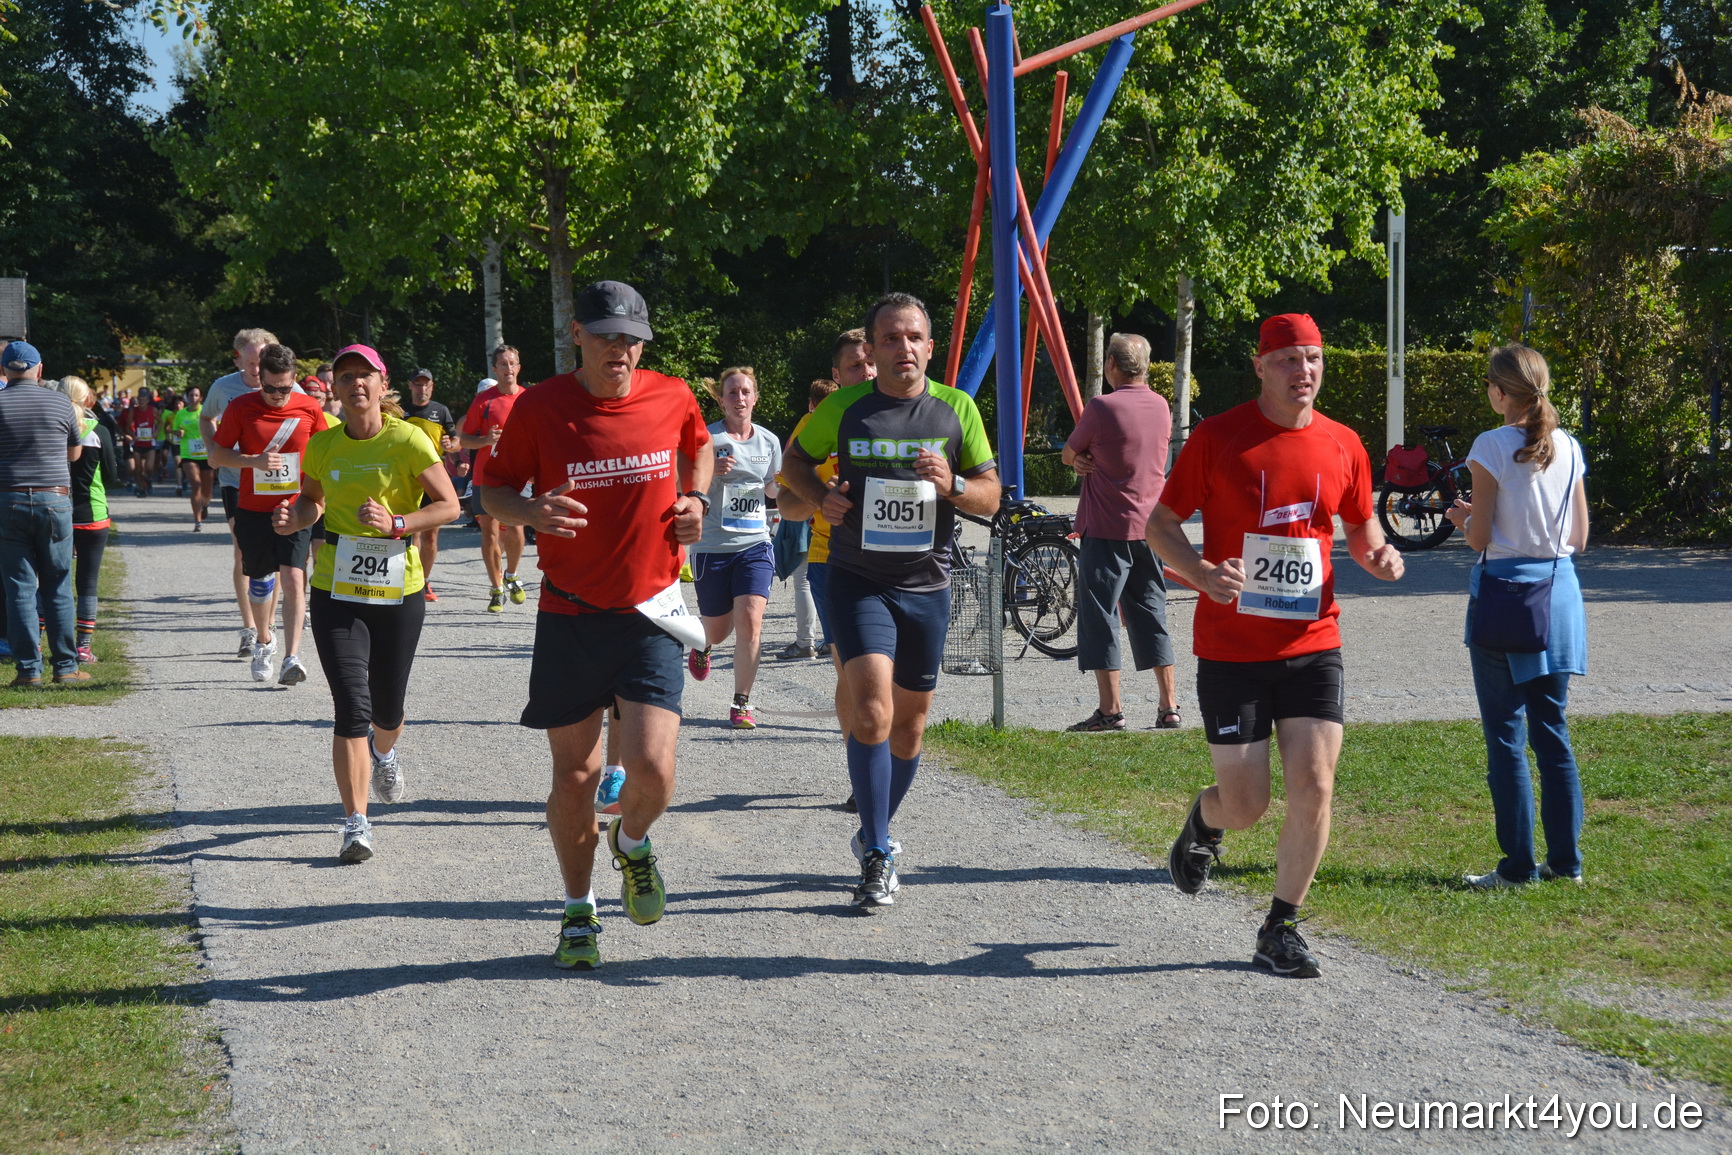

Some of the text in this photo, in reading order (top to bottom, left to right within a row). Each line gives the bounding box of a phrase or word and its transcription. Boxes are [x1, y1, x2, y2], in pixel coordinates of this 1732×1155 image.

[848, 438, 949, 460] BOCK
[567, 450, 670, 475] FACKELMANN
[623, 474, 651, 484] KÜCHE
[659, 470, 671, 479] BAD
[885, 486, 918, 495] BOCK
[730, 498, 760, 513] 3002
[874, 499, 925, 522] 3051
[1277, 509, 1298, 519] DEHN
[356, 543, 388, 552] BOCK
[1269, 543, 1305, 554] BOCK
[351, 555, 389, 577] 294
[1254, 558, 1313, 585] 2469
[355, 586, 385, 597] Martina
[1265, 597, 1298, 610] Robert
